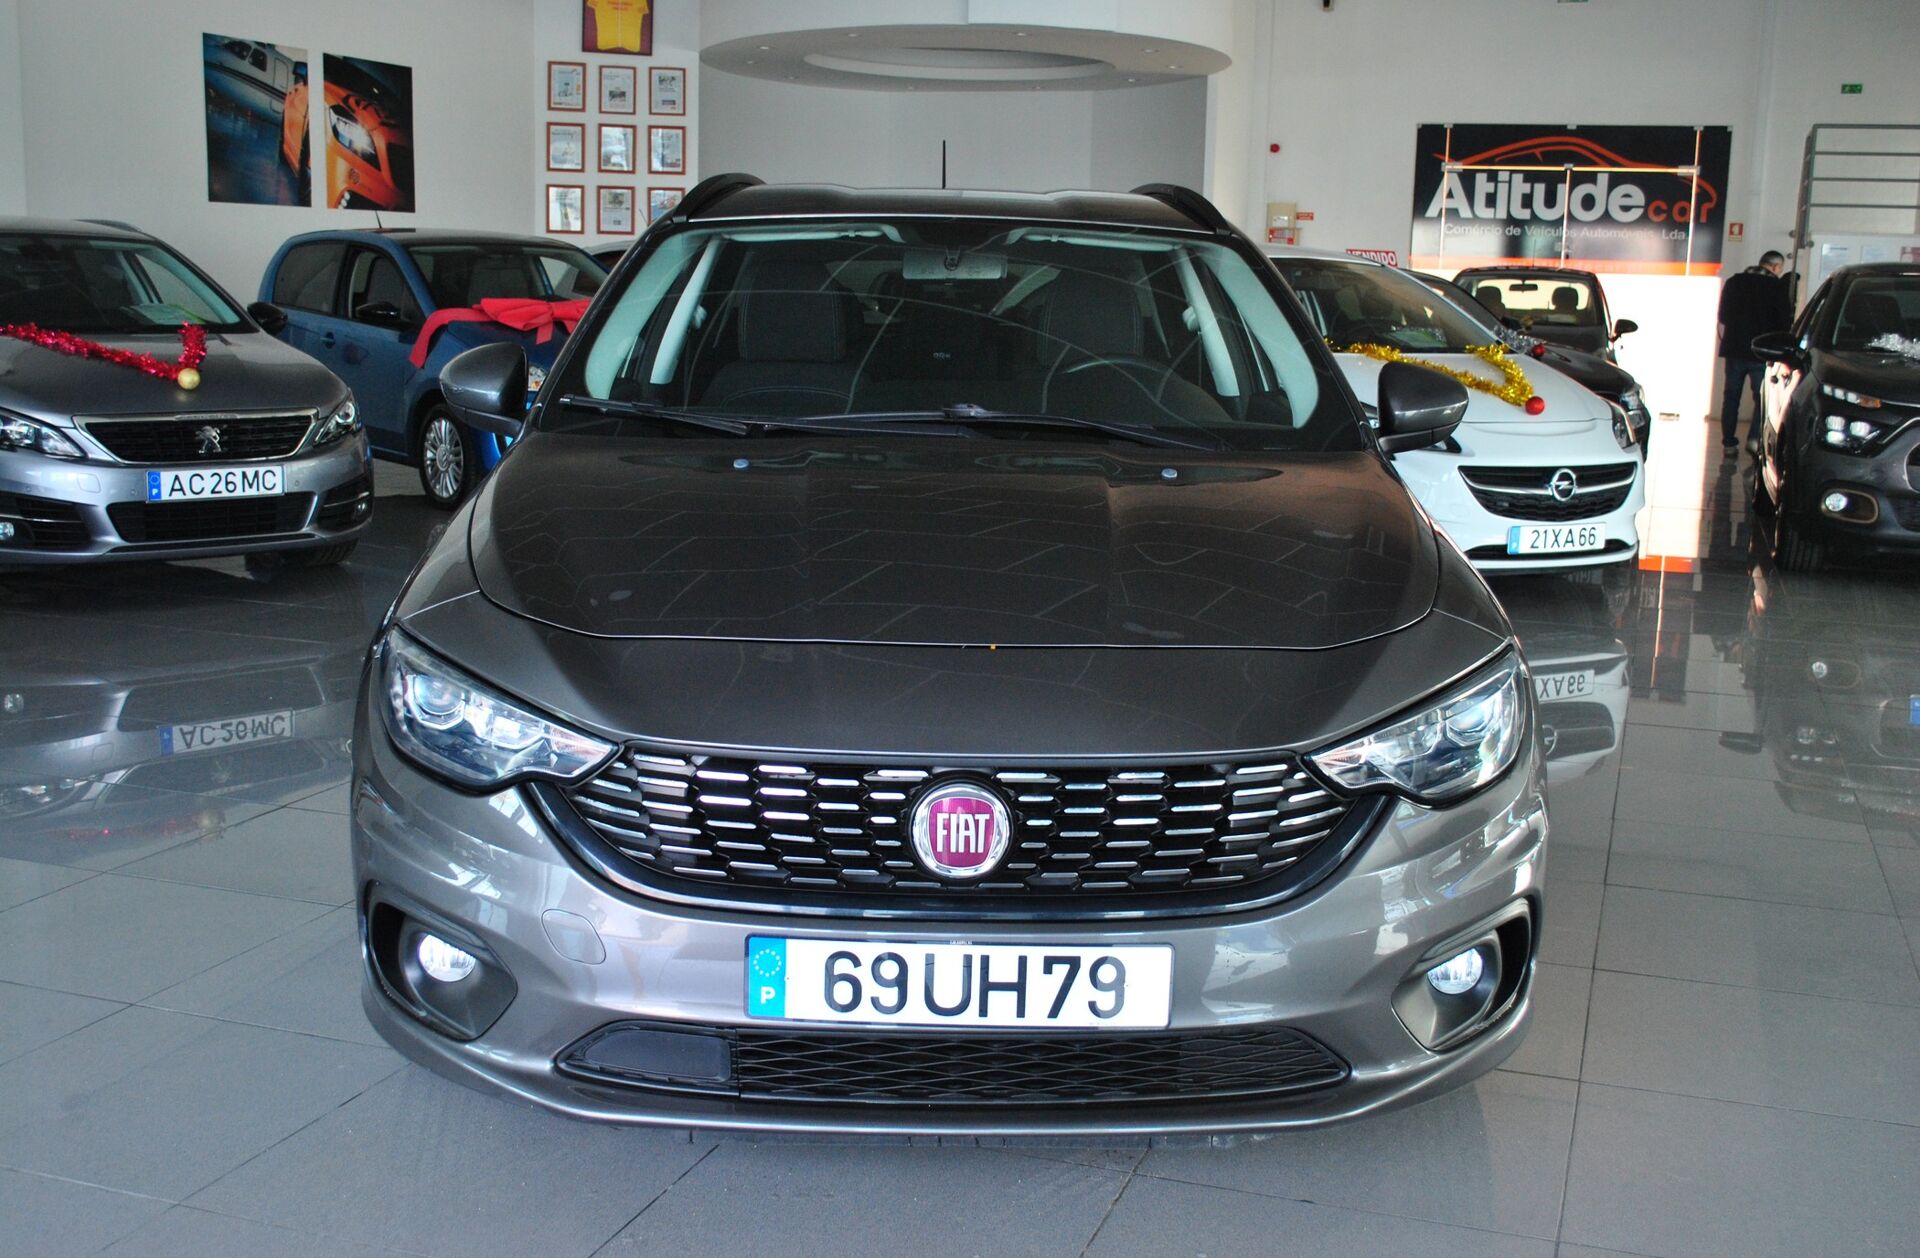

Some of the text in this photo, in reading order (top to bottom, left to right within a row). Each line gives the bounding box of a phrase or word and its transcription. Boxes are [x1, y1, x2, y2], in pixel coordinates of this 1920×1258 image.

[1425, 171, 1645, 223] Atitude
[1505, 225, 1521, 236] de
[936, 812, 991, 854] FIAT
[760, 950, 1128, 1020] P 69UH79
